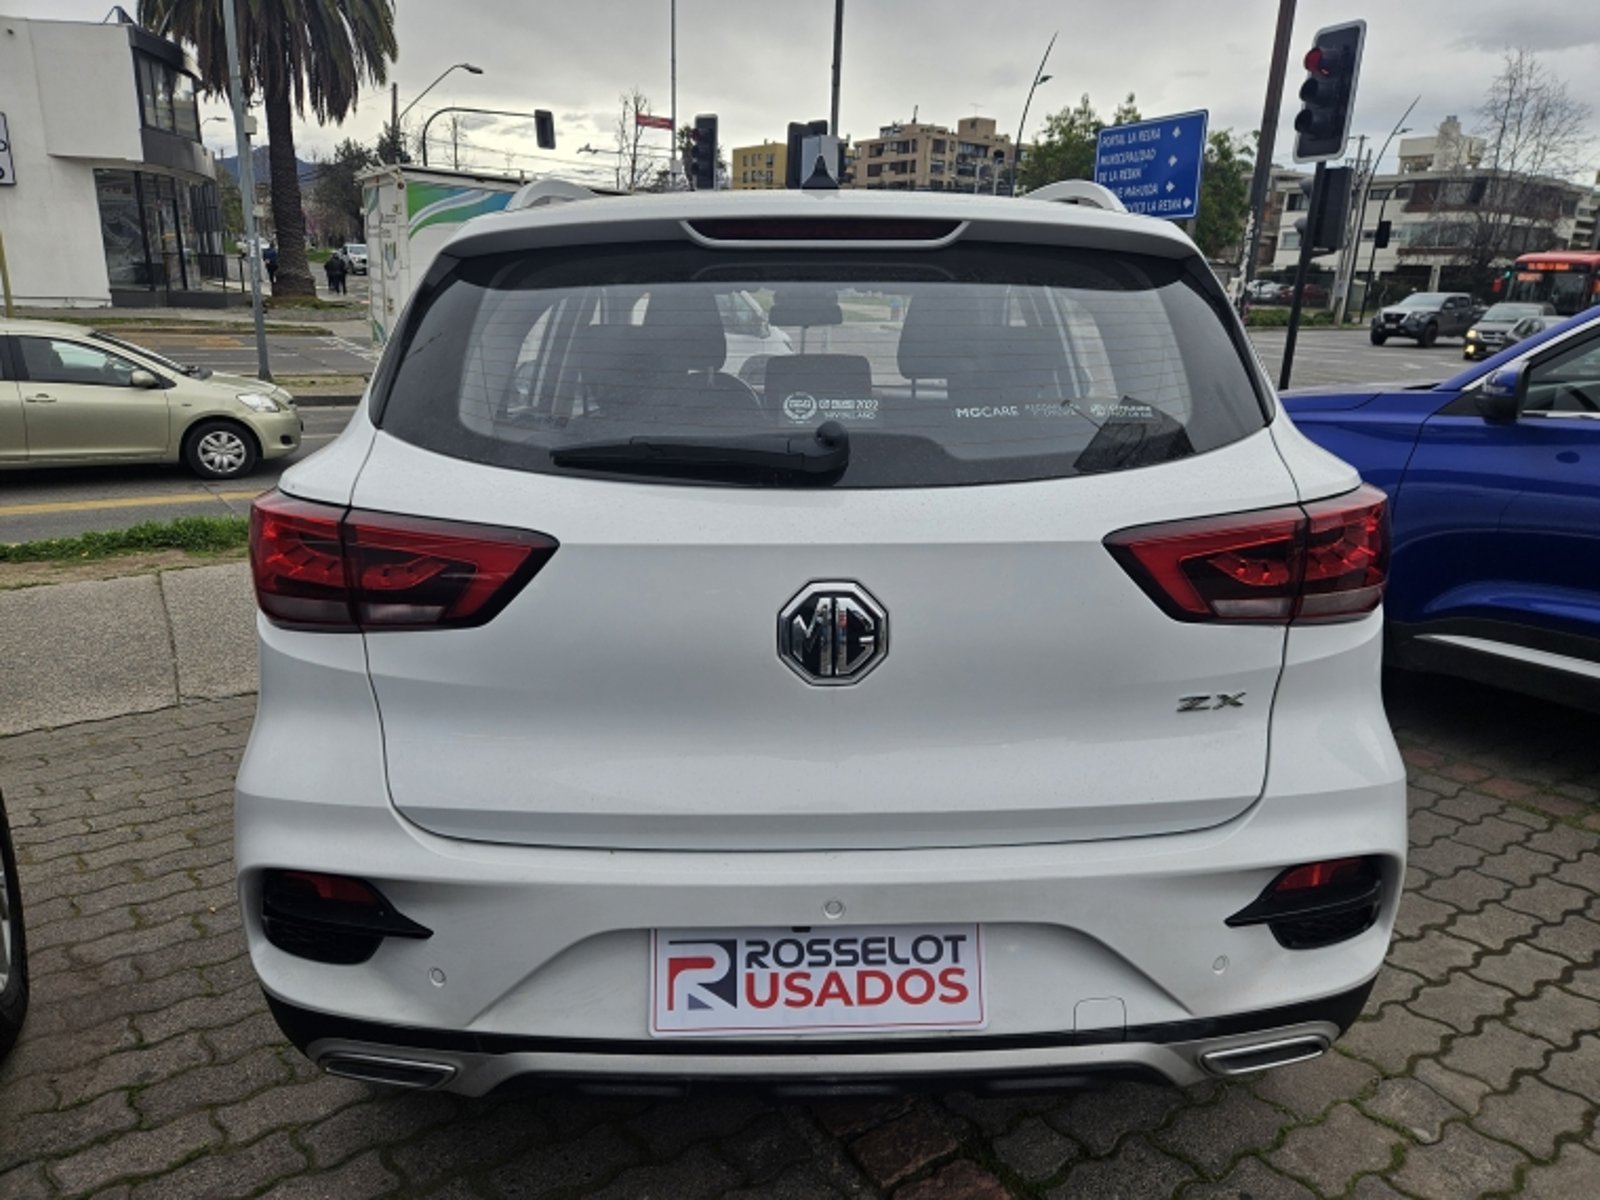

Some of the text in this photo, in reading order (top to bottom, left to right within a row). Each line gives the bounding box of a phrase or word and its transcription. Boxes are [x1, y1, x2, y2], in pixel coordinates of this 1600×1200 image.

[1127, 131, 1136, 144] LA
[1138, 128, 1161, 142] REINA
[1100, 148, 1157, 165] MUNICIPALIDAD
[1109, 170, 1117, 182] LA
[1119, 168, 1142, 180] REINA
[1147, 200, 1156, 212] LA
[1158, 198, 1182, 211] REINA
[792, 597, 875, 676] MG
[1176, 691, 1247, 712] ZX
[745, 934, 967, 969] ROSSELOT
[745, 967, 969, 1009] USADOS
